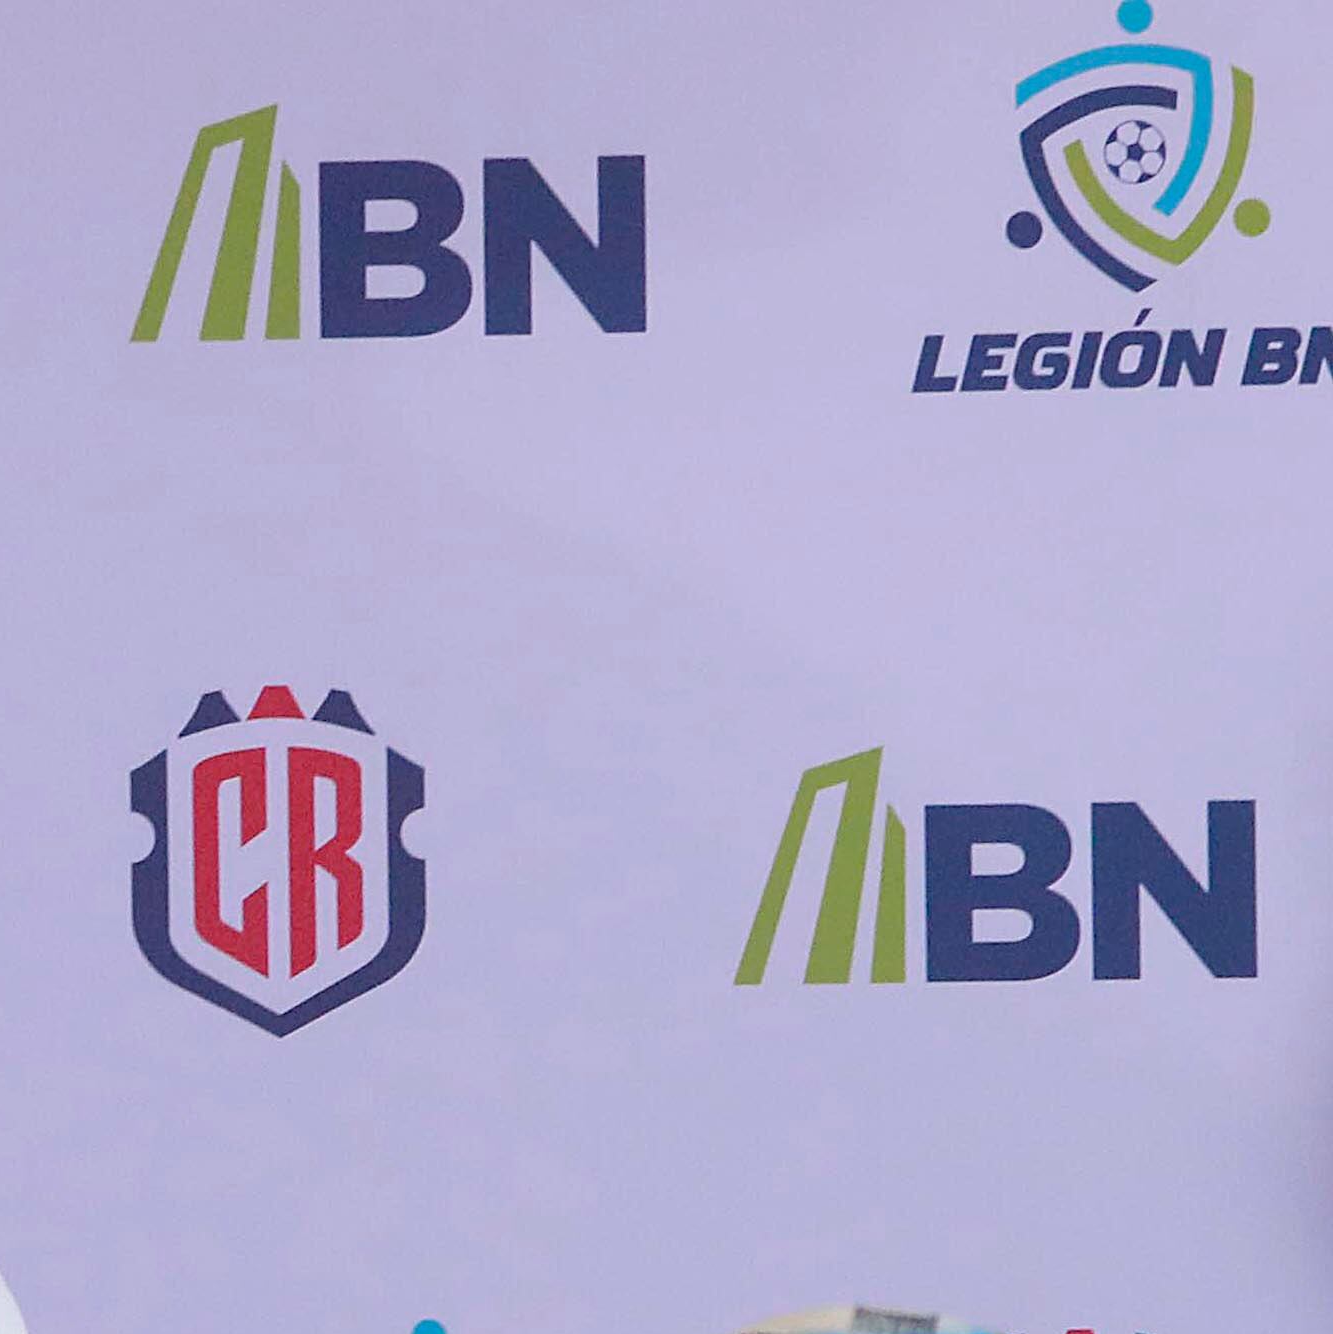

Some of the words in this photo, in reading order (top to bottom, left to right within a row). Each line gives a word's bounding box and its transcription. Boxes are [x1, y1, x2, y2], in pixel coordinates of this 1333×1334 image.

[318, 154, 647, 339] BN
[912, 307, 1227, 393] LEGIÓN
[192, 746, 365, 977] CR
[924, 799, 1258, 983] BN
